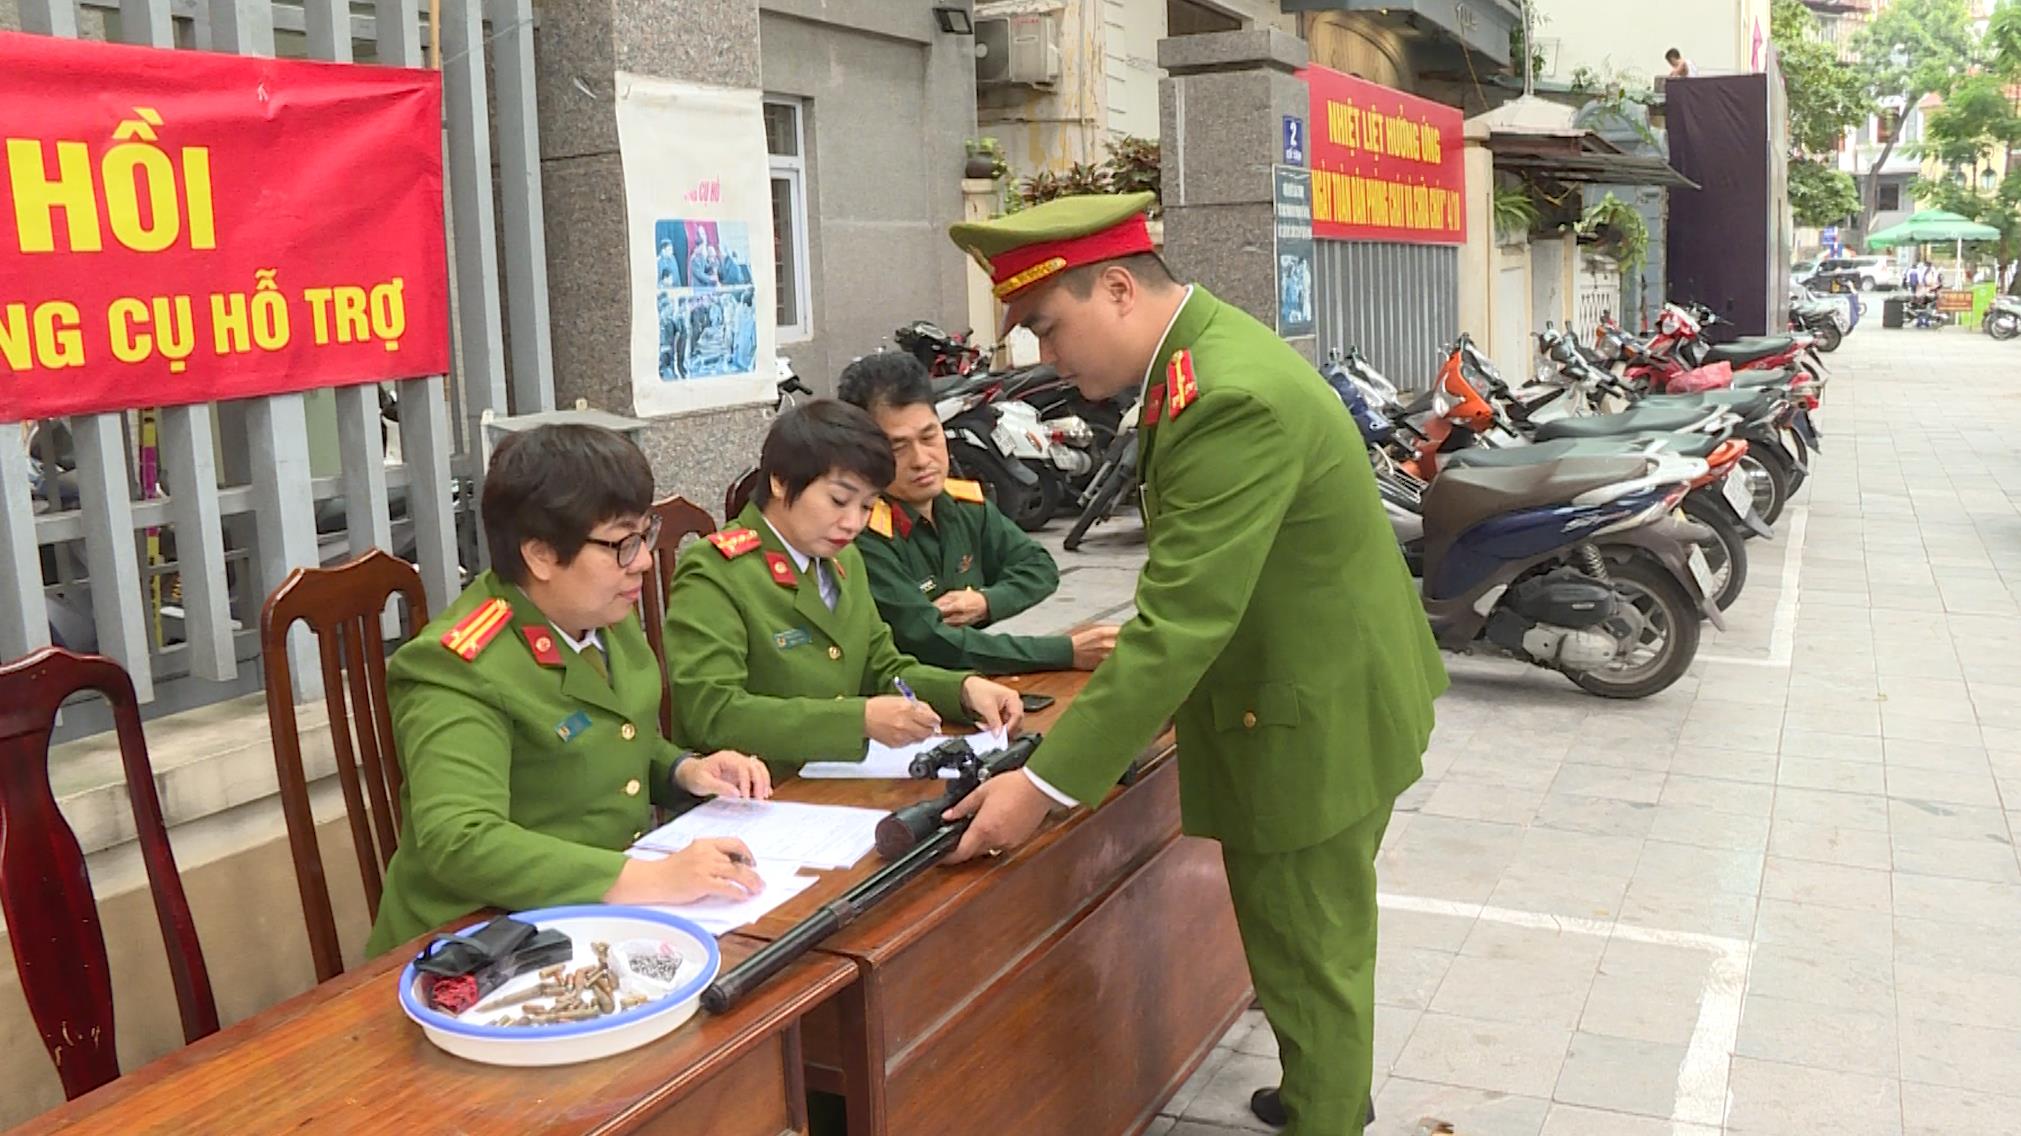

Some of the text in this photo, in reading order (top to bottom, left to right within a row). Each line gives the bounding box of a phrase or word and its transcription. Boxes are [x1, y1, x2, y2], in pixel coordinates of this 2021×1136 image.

[1289, 121, 1298, 147] 2
[1326, 97, 1442, 165] NHIỆT LIỆT HƯỞNG ỨNG
[6, 107, 217, 253] HỒI
[107, 295, 195, 374] CỤ
[210, 268, 291, 356] HỖ
[304, 277, 407, 352] TRỢ
